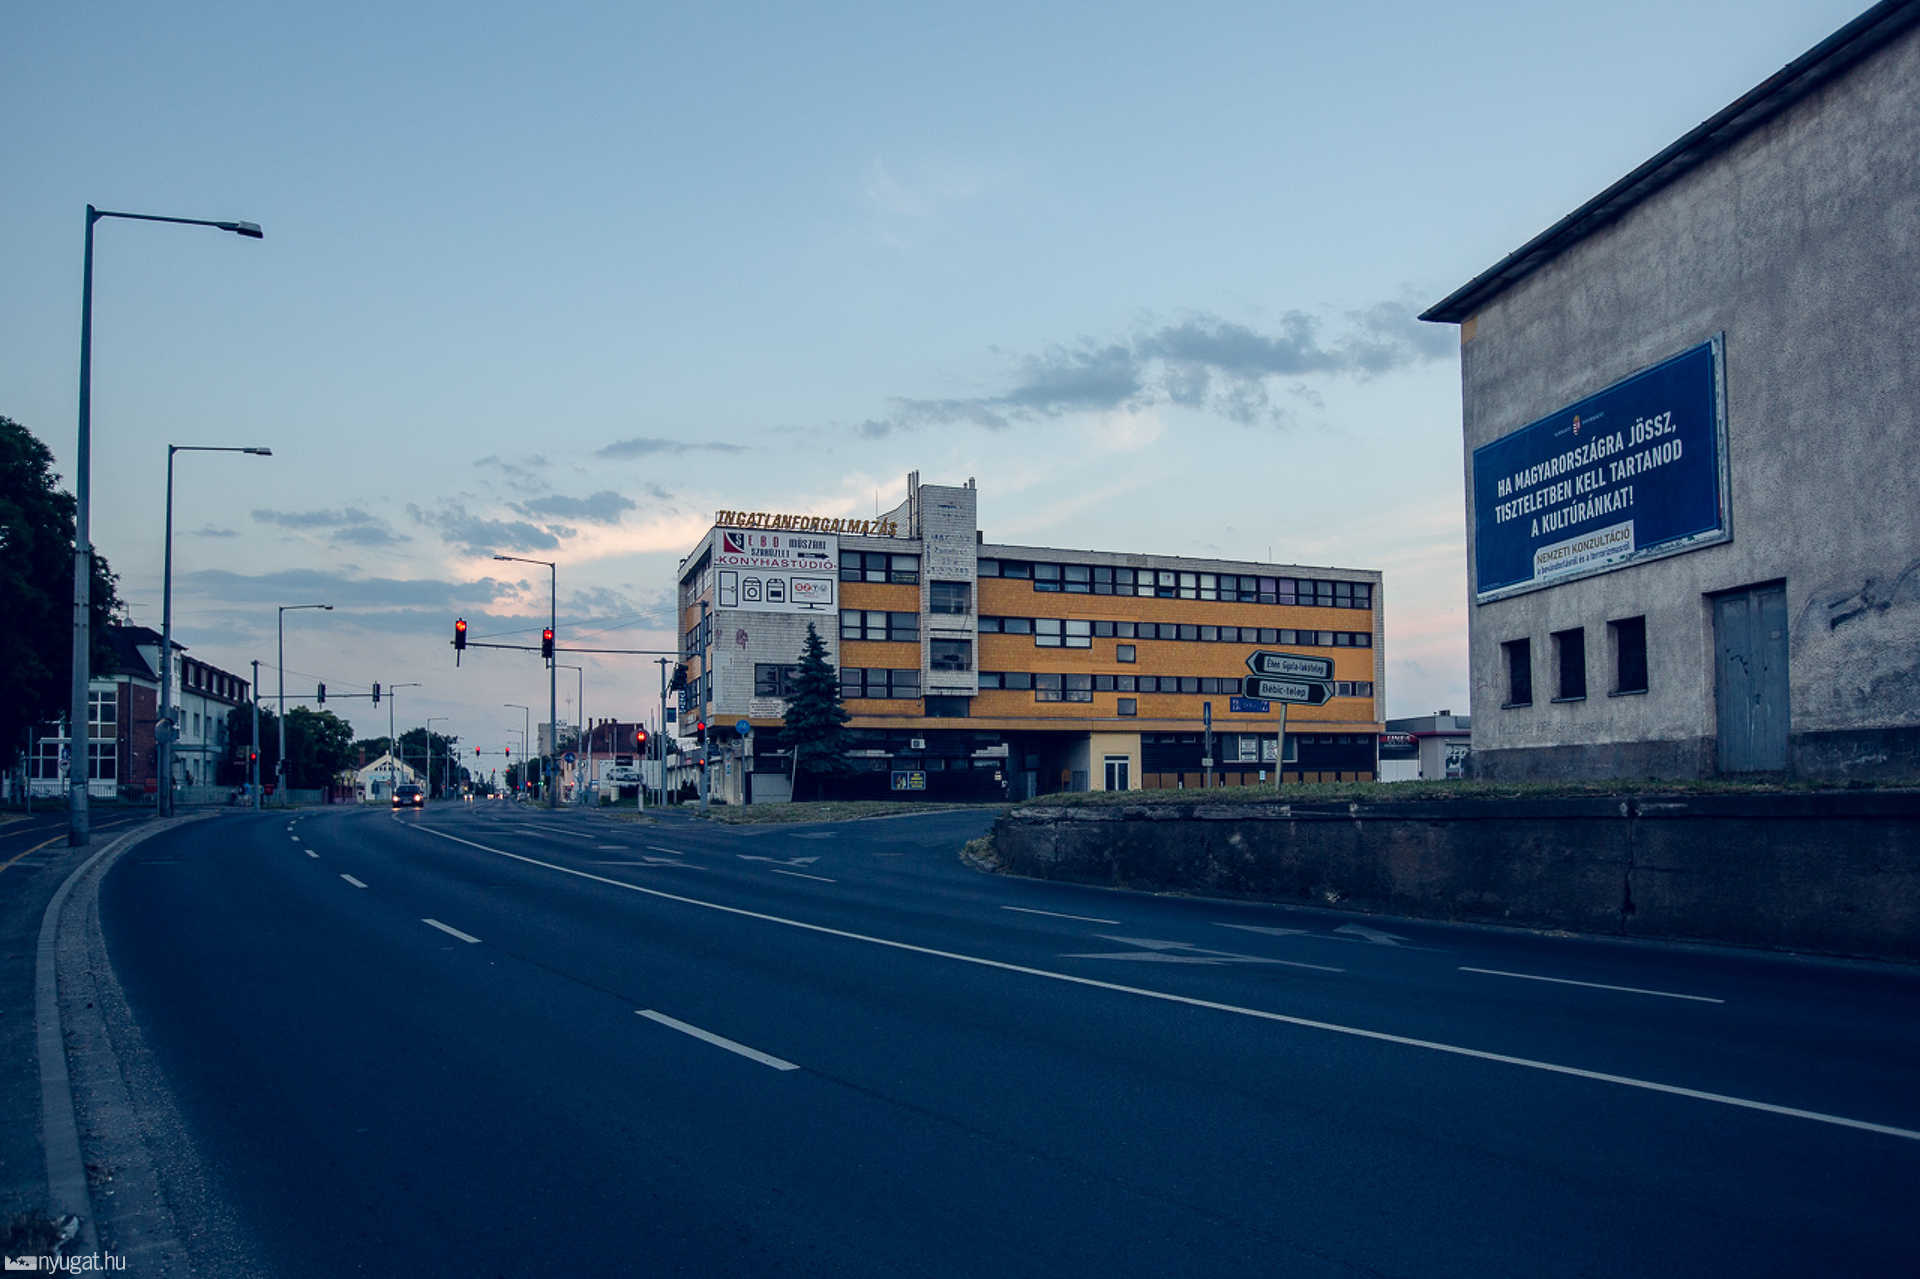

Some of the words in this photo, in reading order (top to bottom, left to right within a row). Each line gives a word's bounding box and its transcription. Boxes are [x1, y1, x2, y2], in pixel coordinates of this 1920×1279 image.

[1497, 480, 1513, 498] HA
[1515, 432, 1625, 492] MAGYARORSZÁGRA
[1628, 411, 1677, 447] JÖSSZ,
[1495, 480, 1572, 524] TISZTELETBEN
[1575, 467, 1607, 496] KELL
[1609, 439, 1683, 482] TARTANOD
[716, 510, 898, 536] INGATLANFORGALMAZÁS
[1530, 518, 1540, 538] A
[1542, 485, 1634, 534] KULTÚRÁNKAT!
[1537, 546, 1571, 565] NEMZETI
[1572, 526, 1630, 554] KONZULTÁCIÓ
